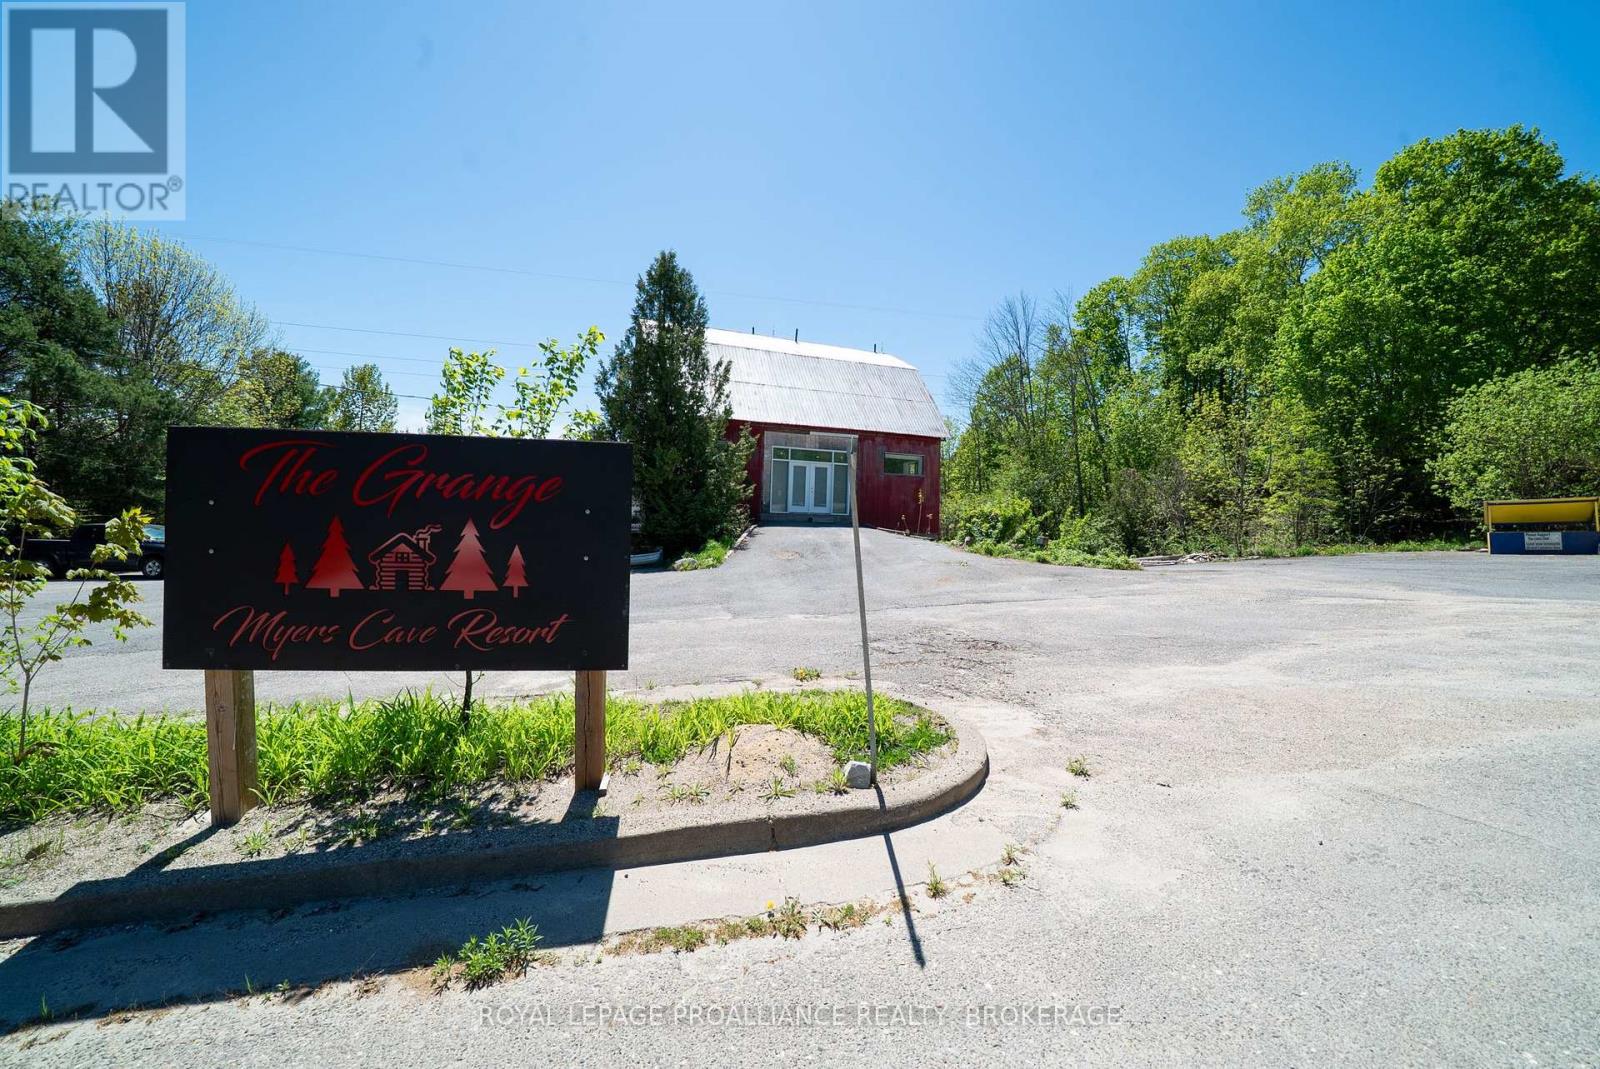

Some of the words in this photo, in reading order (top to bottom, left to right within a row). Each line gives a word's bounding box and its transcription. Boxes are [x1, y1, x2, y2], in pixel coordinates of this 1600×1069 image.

[240, 440, 338, 505] The
[353, 444, 564, 529] Grange
[213, 605, 341, 660] Myers
[350, 609, 436, 650] Cave
[448, 609, 569, 650] Resort
